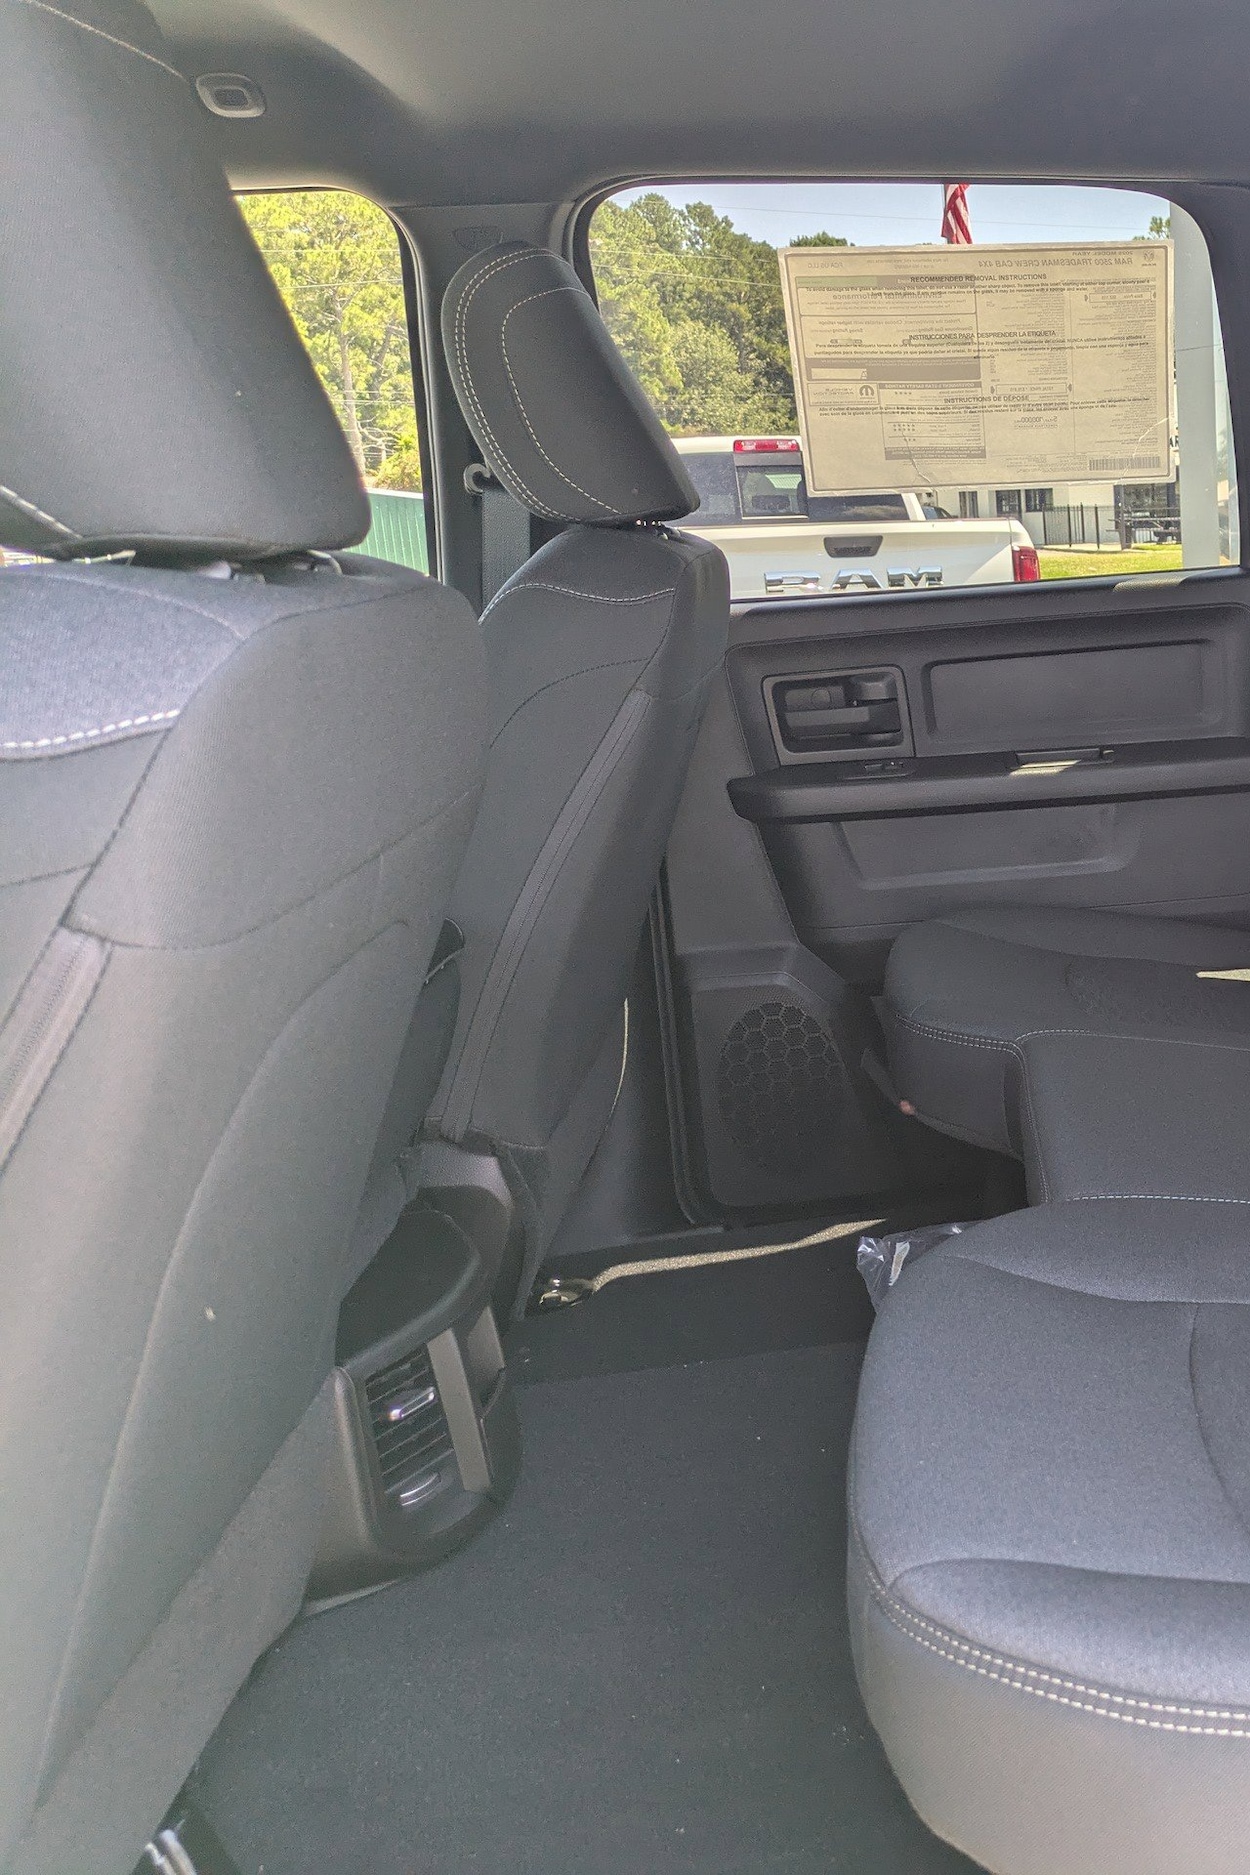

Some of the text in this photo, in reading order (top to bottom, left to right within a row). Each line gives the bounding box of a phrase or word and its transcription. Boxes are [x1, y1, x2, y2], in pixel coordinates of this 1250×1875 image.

[910, 275, 963, 283] RECOMMENDED
[965, 274, 997, 282] REMOVAL
[999, 273, 1048, 281] INSTRUCTIONS
[763, 566, 945, 595] RAM
